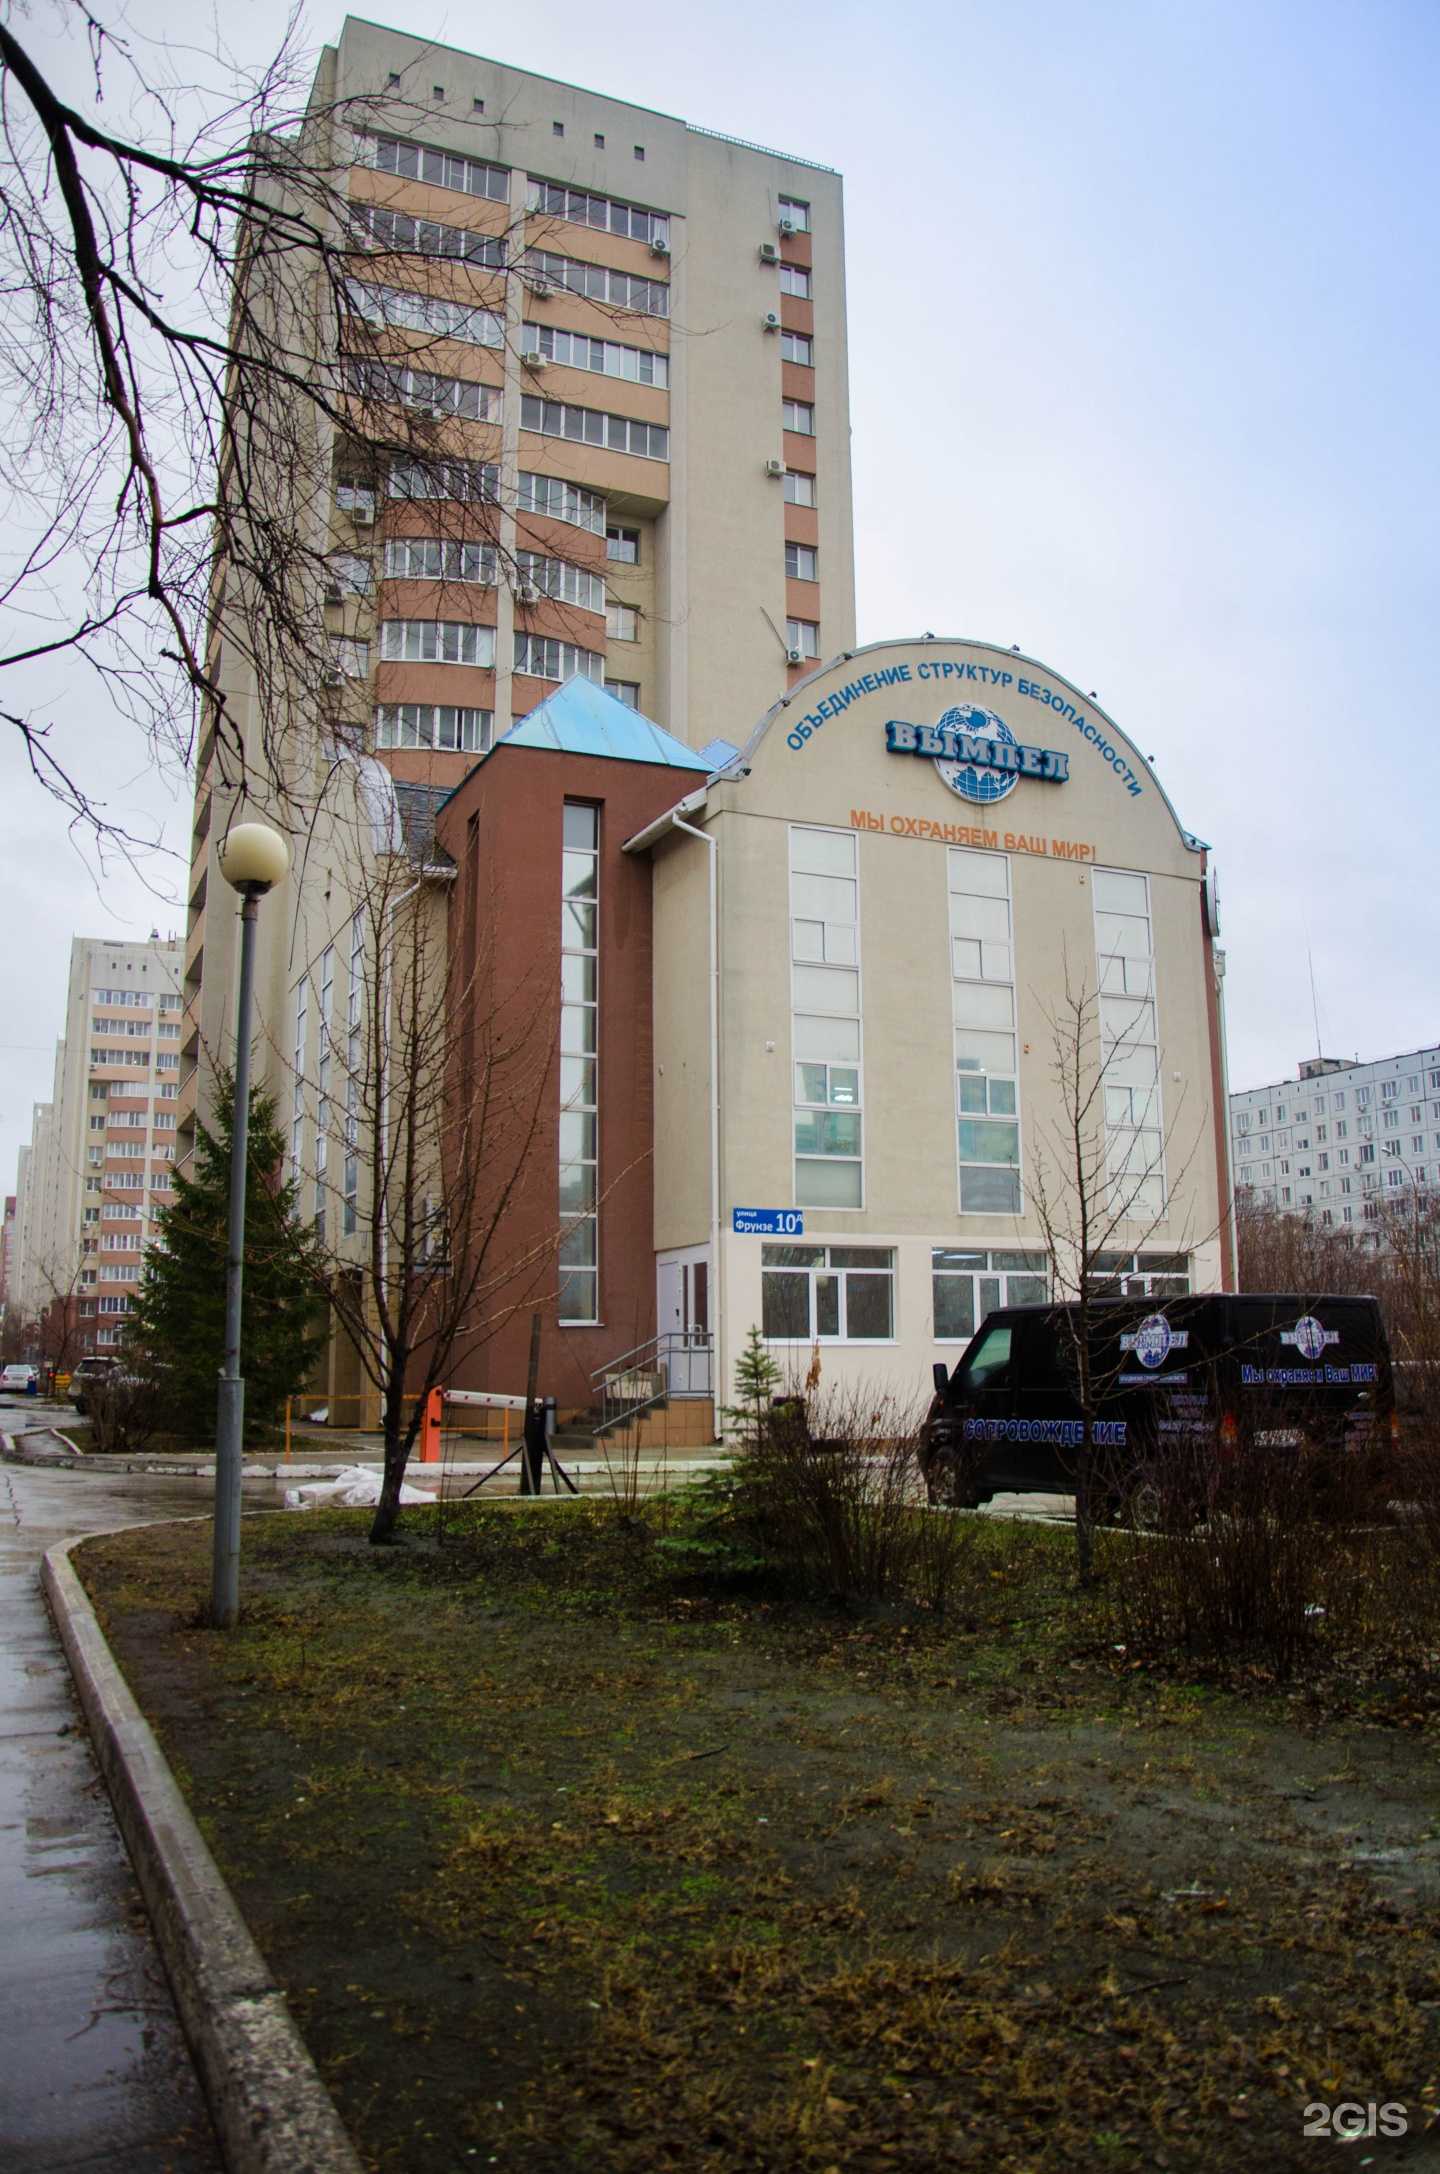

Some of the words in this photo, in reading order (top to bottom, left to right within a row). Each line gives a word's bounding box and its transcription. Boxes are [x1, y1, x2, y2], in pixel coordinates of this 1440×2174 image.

[786, 664, 912, 751] ОБЪЕДИНЕНИЕ
[917, 662, 1013, 687] СТРУКТУР
[1018, 678, 1142, 797] БЕЗОПАСНОСТИ
[885, 720, 1069, 783] ВЫМПЕЛ
[850, 809, 884, 831] МЫ
[890, 815, 998, 849] ОХРАНЯЕМ
[1004, 832, 1047, 855] ВАШ
[1052, 839, 1096, 862] МИР!
[735, 1219, 773, 1233] Фрунзе
[1241, 1363, 1265, 1384] Мы
[1324, 1363, 1350, 1384] Ваш
